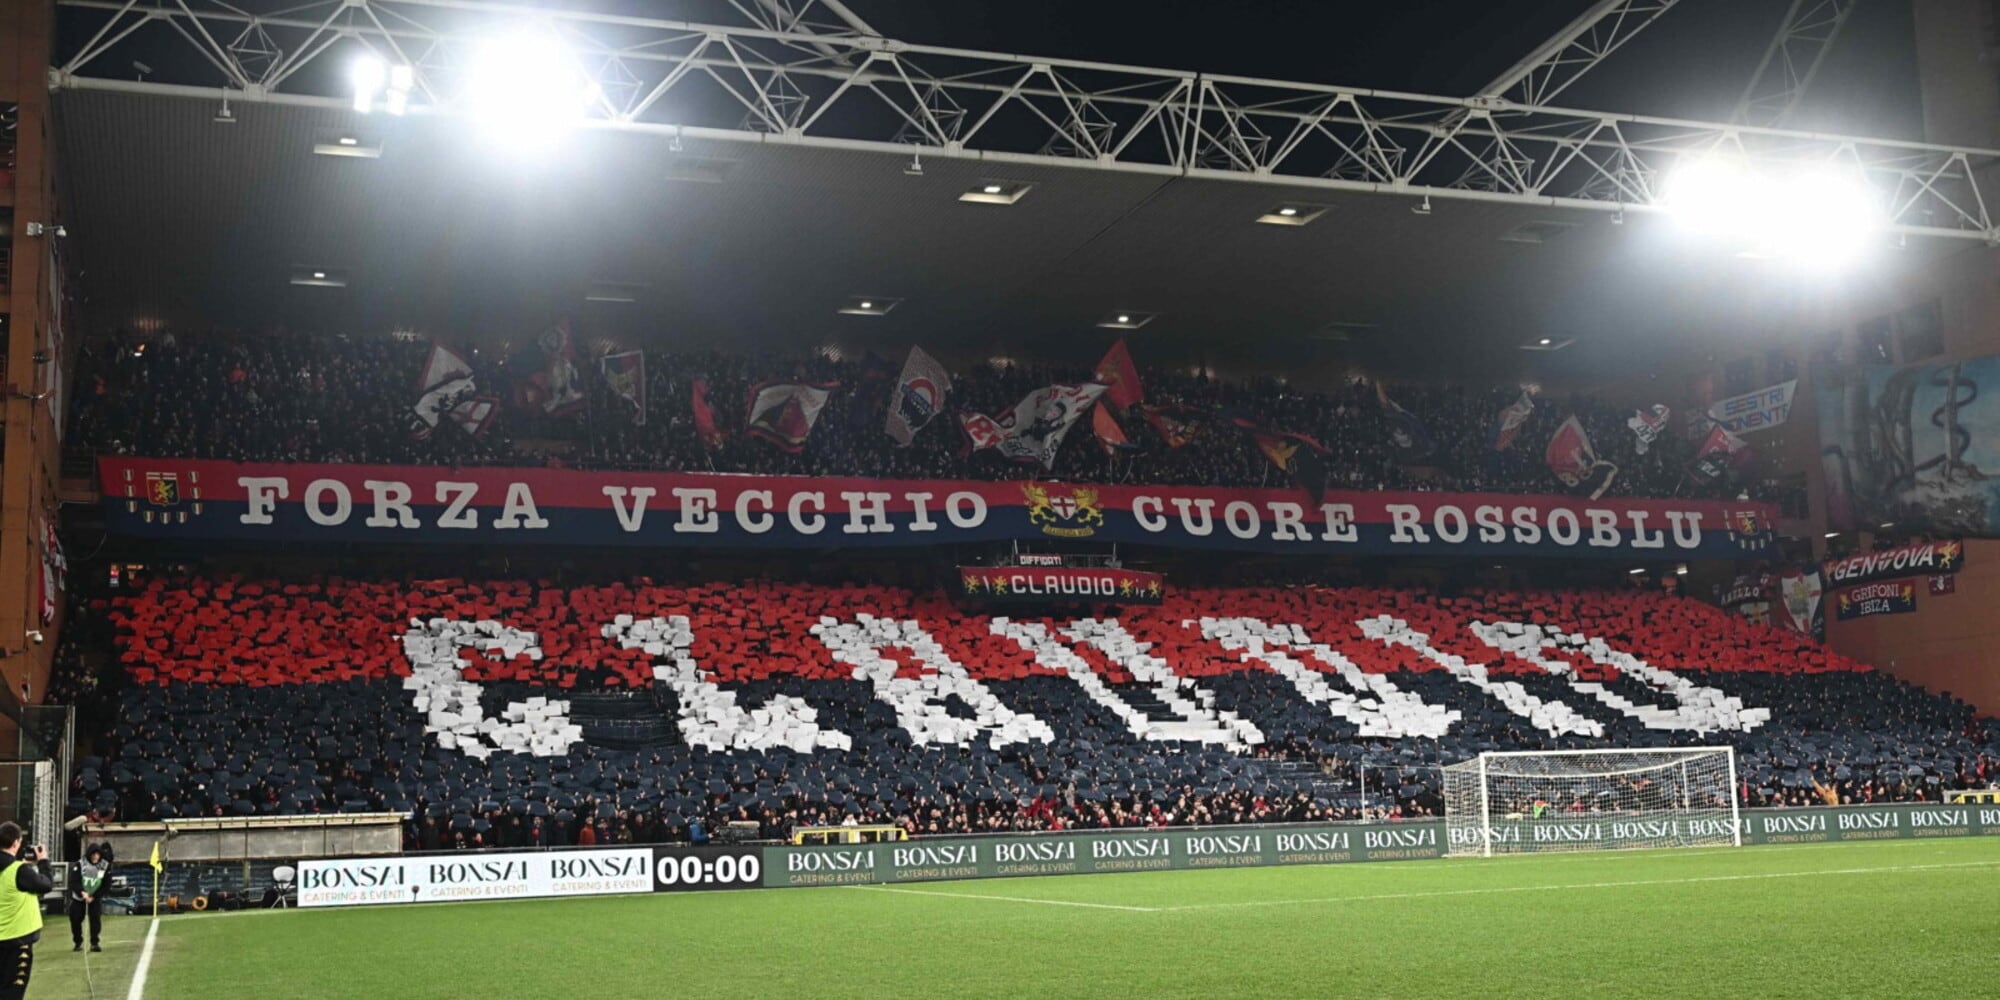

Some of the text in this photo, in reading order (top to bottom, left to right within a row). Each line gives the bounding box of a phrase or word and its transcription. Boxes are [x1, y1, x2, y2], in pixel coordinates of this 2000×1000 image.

[1725, 387, 1784, 416] SESTRI
[238, 477, 1703, 549] FORZA VECCHIO CUORE ROSSOBLU
[1011, 575, 1115, 596] CLAUDIO
[1852, 584, 1899, 602] GRIFONI
[1860, 599, 1890, 615] IBIZA
[1764, 815, 1825, 833] BONSAI
[1839, 812, 1899, 830] BONSAI
[1911, 810, 1968, 827] BONSAI
[1365, 828, 1435, 848] BONSAI
[1534, 823, 1600, 841] BONSAI
[1613, 821, 1677, 839] BONSAI
[1093, 838, 1169, 858] BONSAI
[1187, 835, 1261, 855] BONSAI
[1277, 832, 1349, 851] BONSAI
[788, 851, 874, 871] BONSAI
[894, 846, 977, 867] BONSAI
[995, 842, 1074, 862] BONSAI
[303, 866, 404, 888] BONSAI
[430, 861, 527, 883] BONSAI
[551, 857, 645, 878] BONSAI
[657, 855, 759, 885] 00:00
